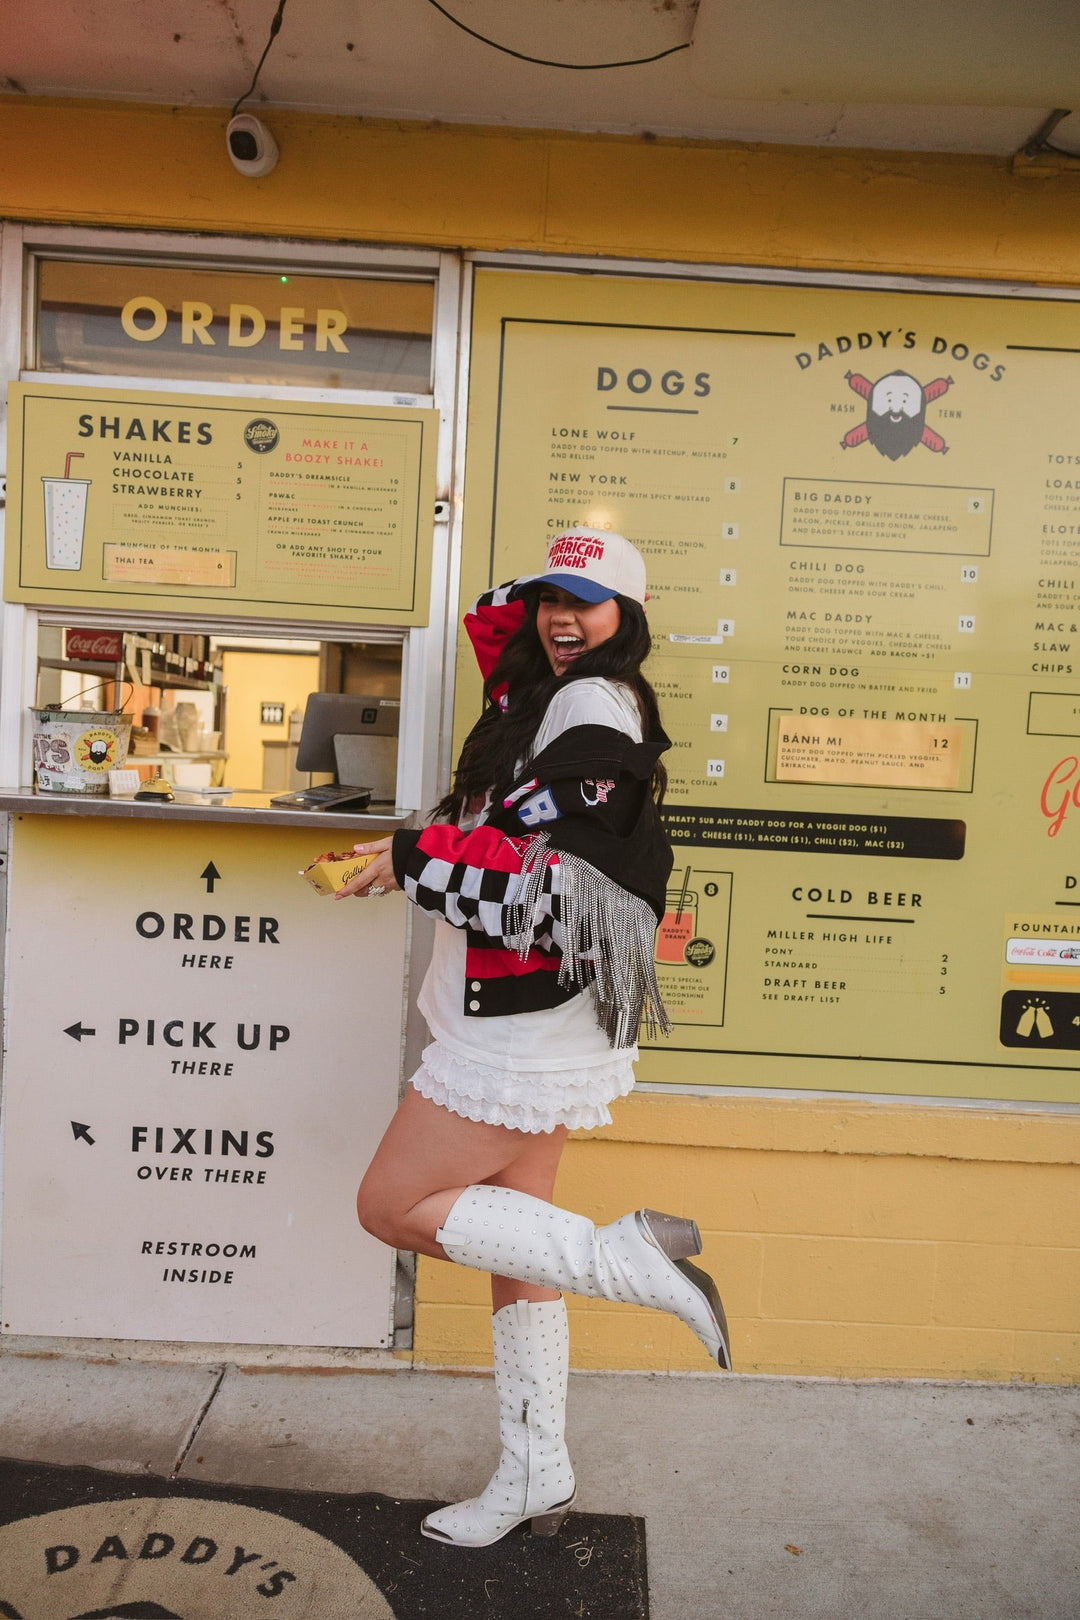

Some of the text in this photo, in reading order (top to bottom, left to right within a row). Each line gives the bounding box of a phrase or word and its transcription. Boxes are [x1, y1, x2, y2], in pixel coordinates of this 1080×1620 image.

[121, 296, 349, 353] ORDER
[795, 328, 1006, 382] DADDY'S DOGS
[597, 367, 710, 397] DOGS
[830, 404, 962, 418] NASH TENN
[79, 415, 212, 445] SHAKES
[552, 428, 636, 441] LONE WOLF
[302, 439, 368, 451] MAKE IT A
[113, 452, 172, 464] VANILLA
[653, 449, 688, 457] KETCHUP,
[1048, 454, 1080, 465] TOTS
[285, 453, 383, 467] BOOZY SHAKE!
[113, 468, 194, 481] CHOCOLATE
[550, 472, 627, 484] NEW YORK
[113, 484, 202, 498] STRAWBERRY
[730, 482, 735, 490] 8
[795, 492, 872, 504] BIG DADDY
[292, 551, 326, 559] FAVORITE
[549, 541, 604, 560] AMERICAN
[549, 555, 587, 568] THIGHS
[790, 561, 865, 573] CHILI DOG
[963, 570, 976, 578] 10
[1039, 579, 1074, 589] CHILI
[787, 611, 873, 623] MAC DADDY
[960, 620, 973, 628] 10
[1035, 622, 1064, 632] MAC
[1034, 642, 1070, 652] SLAW
[782, 665, 859, 677] CORN DOG
[1032, 663, 1072, 674] CHIPS
[958, 677, 969, 685] 11
[801, 707, 946, 722] DOG OF THE MONTH
[934, 739, 948, 748] 12
[669, 815, 695, 823] MEAT?
[870, 826, 887, 834] ($1)
[702, 831, 731, 839] CHEESE
[735, 833, 754, 842] ($1),
[791, 836, 811, 845] ($1),
[839, 838, 858, 847] ($2),
[865, 840, 883, 848] MAC
[887, 841, 904, 849] ($2)
[708, 884, 715, 894] 8
[792, 887, 922, 907] COLD BEER
[136, 911, 280, 944] ORDER
[767, 930, 893, 944] MILLER HIGH LIFE
[181, 954, 234, 969] HERE
[764, 960, 818, 969] STANDARD
[942, 954, 948, 962] 2
[764, 978, 946, 995] DRAFT BEER 5
[784, 994, 815, 1002] DRAFT
[119, 1018, 290, 1051] PICK UP
[171, 1060, 234, 1076] THERE
[132, 1126, 275, 1158] FIXINS
[137, 1166, 267, 1185] OVER THERE
[141, 1241, 257, 1258] RESTROOM
[163, 1268, 234, 1284] INSIDE
[45, 1533, 296, 1598] DADDY'S
